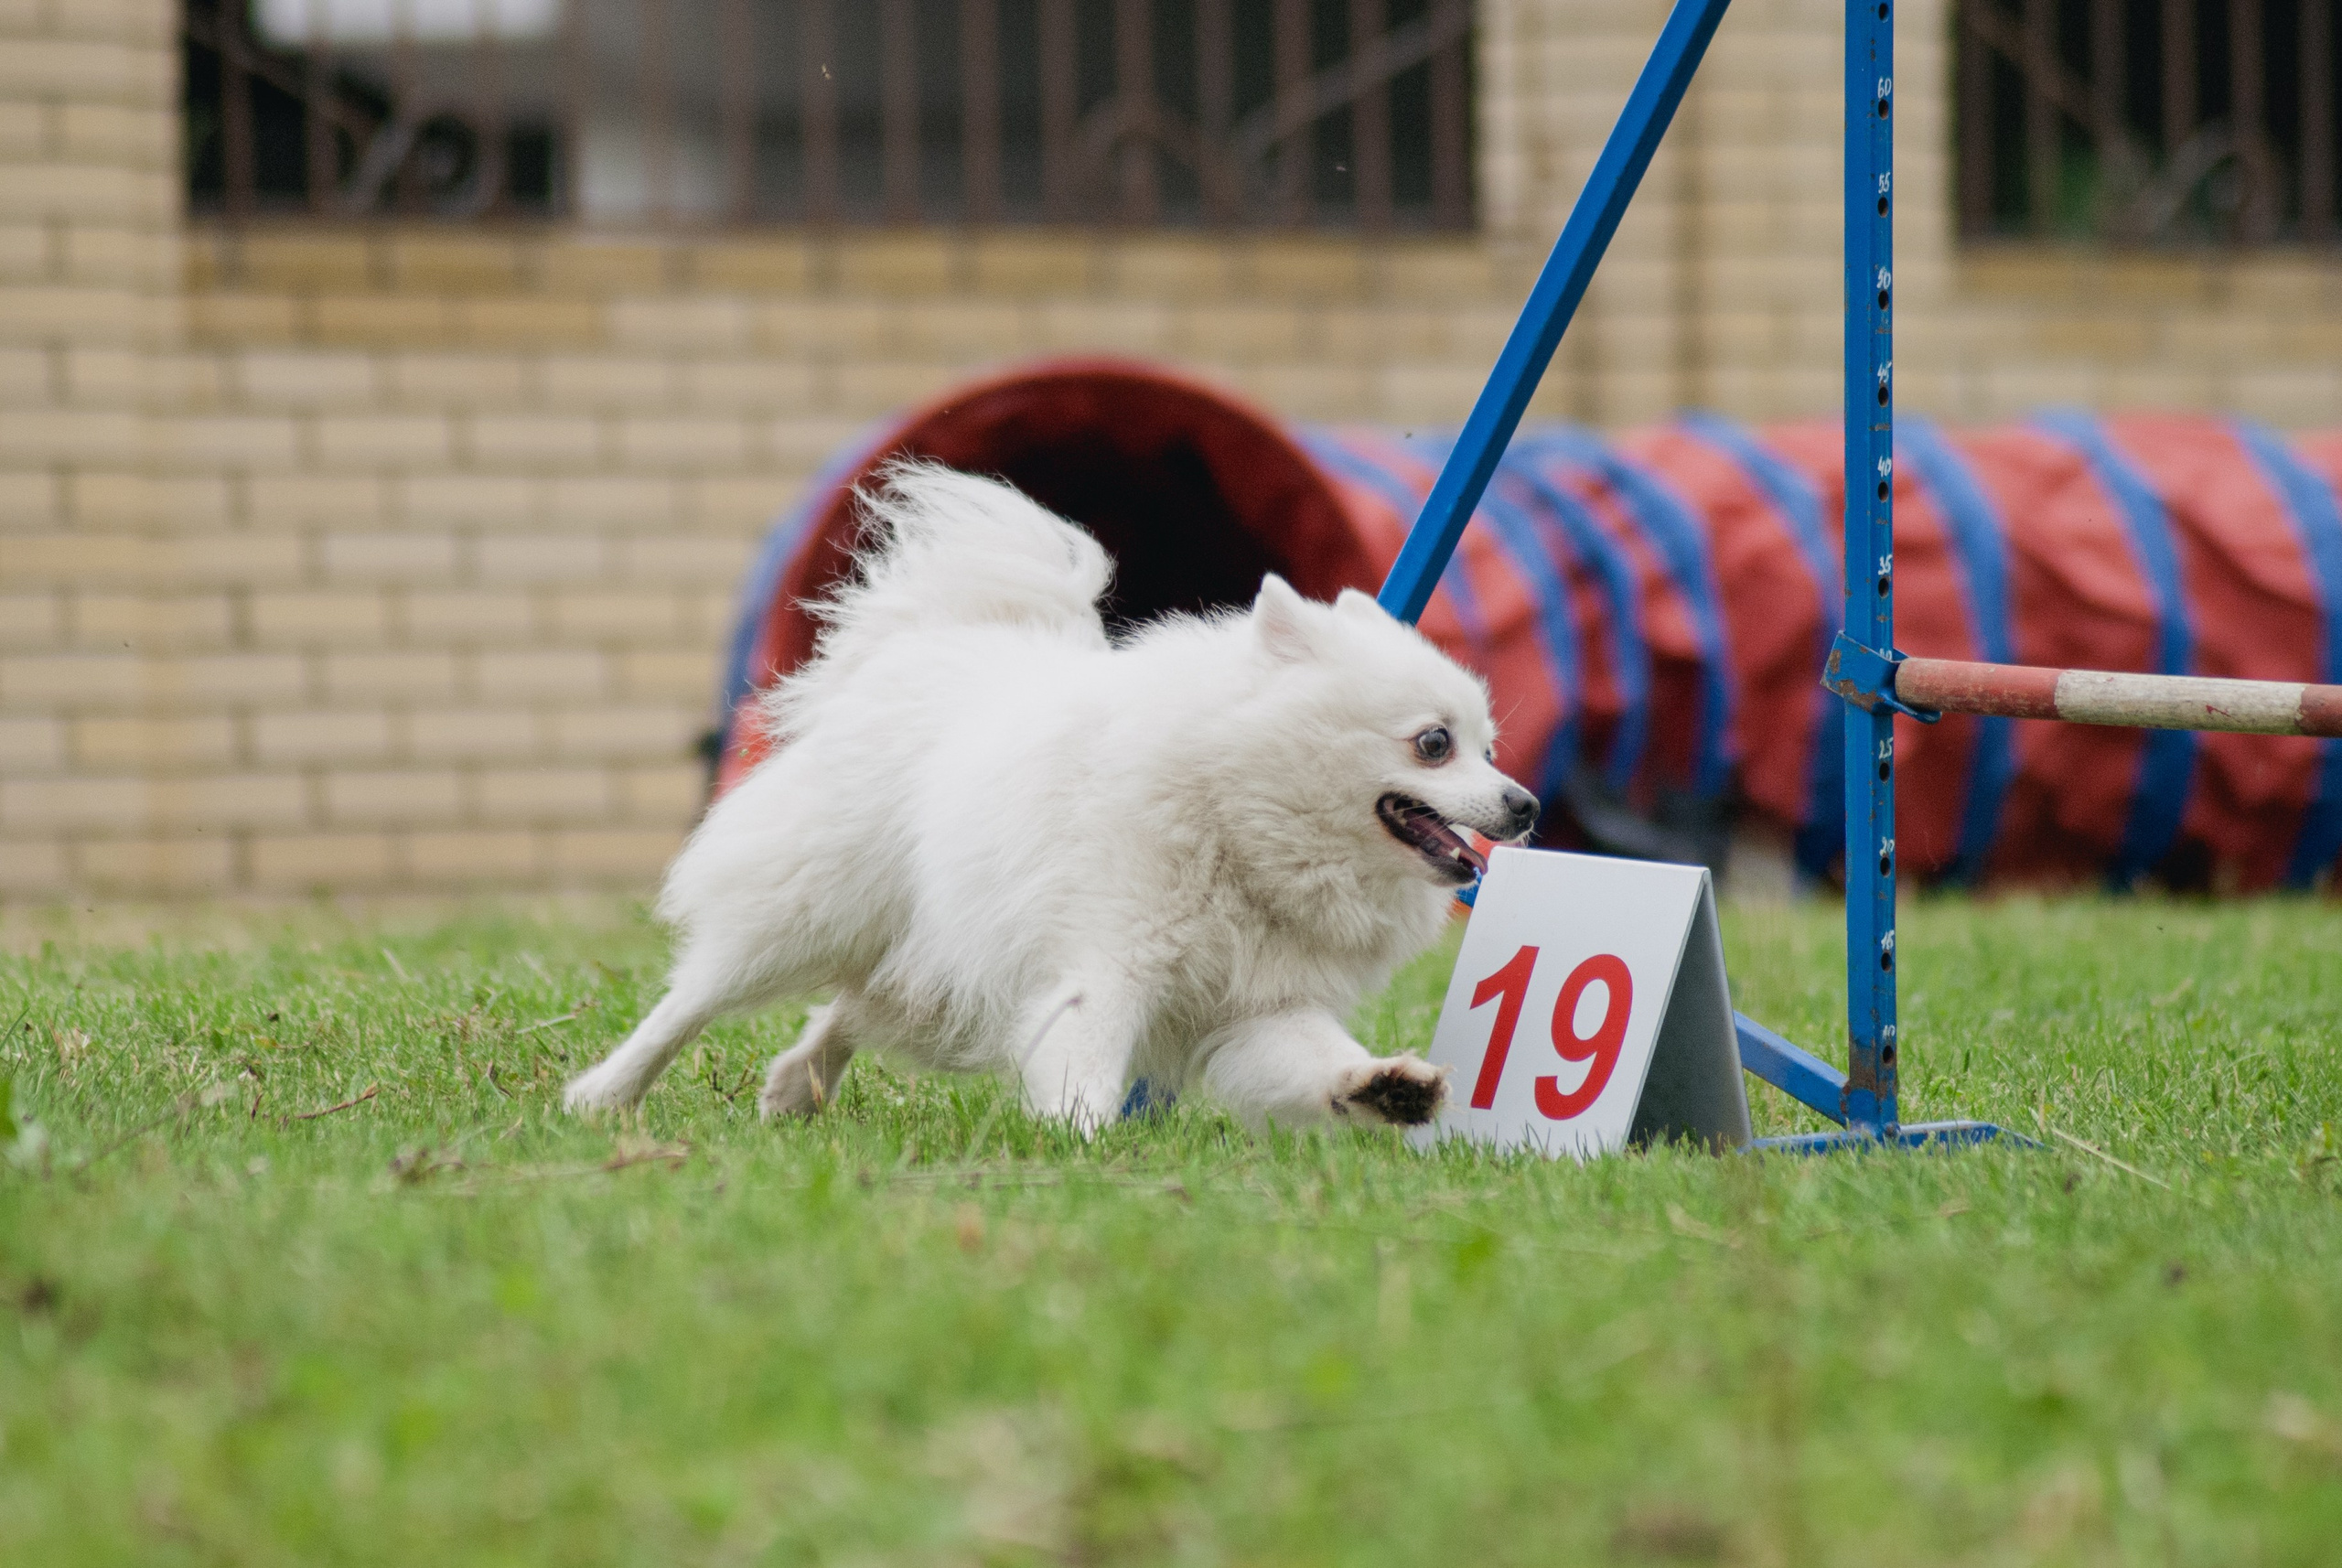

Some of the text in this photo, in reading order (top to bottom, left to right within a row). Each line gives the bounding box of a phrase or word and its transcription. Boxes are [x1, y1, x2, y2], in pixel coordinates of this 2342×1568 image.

[1877, 76, 1892, 99] 60
[1878, 172, 1891, 194] 55
[1876, 266, 1892, 289] 50
[1877, 360, 1892, 383] 45
[1877, 456, 1892, 478] 40
[1877, 554, 1893, 575] 35
[1878, 736, 1894, 759] 25
[1879, 836, 1895, 857] 20
[1469, 945, 1633, 1121] 19
